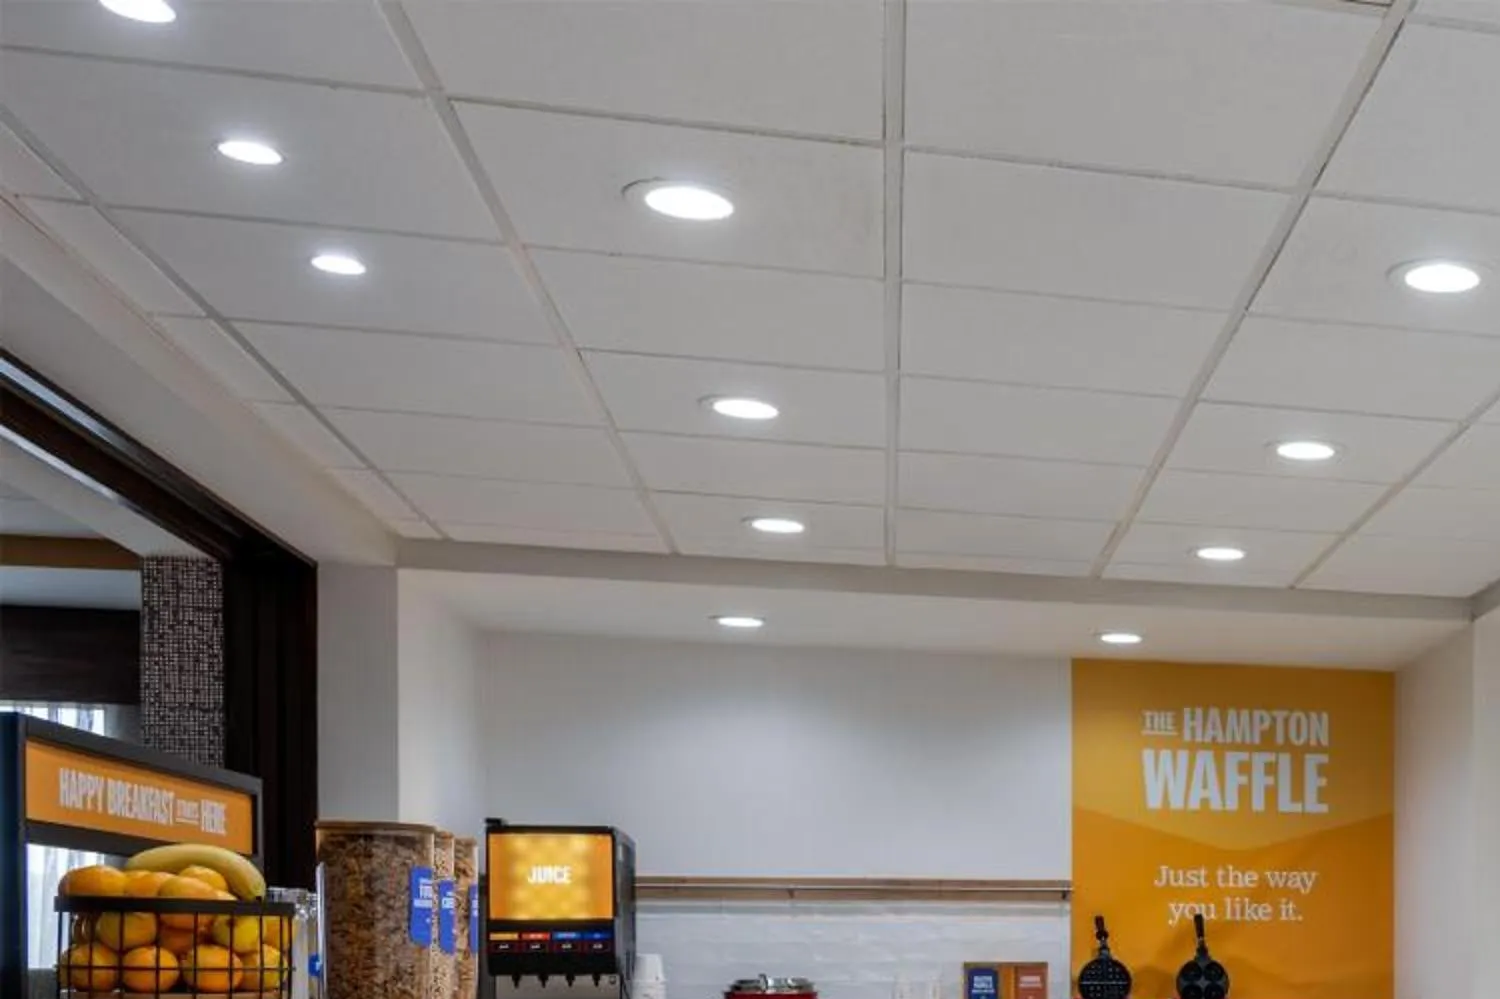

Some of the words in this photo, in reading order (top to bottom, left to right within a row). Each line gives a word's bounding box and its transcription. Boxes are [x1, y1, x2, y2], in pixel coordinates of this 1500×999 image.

[1142, 710, 1177, 734] THE
[1183, 707, 1329, 746] HAMPTON
[60, 768, 104, 812] HAPPY
[107, 777, 174, 825] BREAKFAST
[1142, 748, 1329, 813] WAFFLE
[527, 865, 572, 885] JUICE
[1154, 865, 1209, 887] Just
[1217, 865, 1259, 888] the
[1265, 871, 1317, 894] way
[1168, 902, 1217, 927] you
[1225, 897, 1272, 921] like
[1280, 898, 1304, 921] it.
